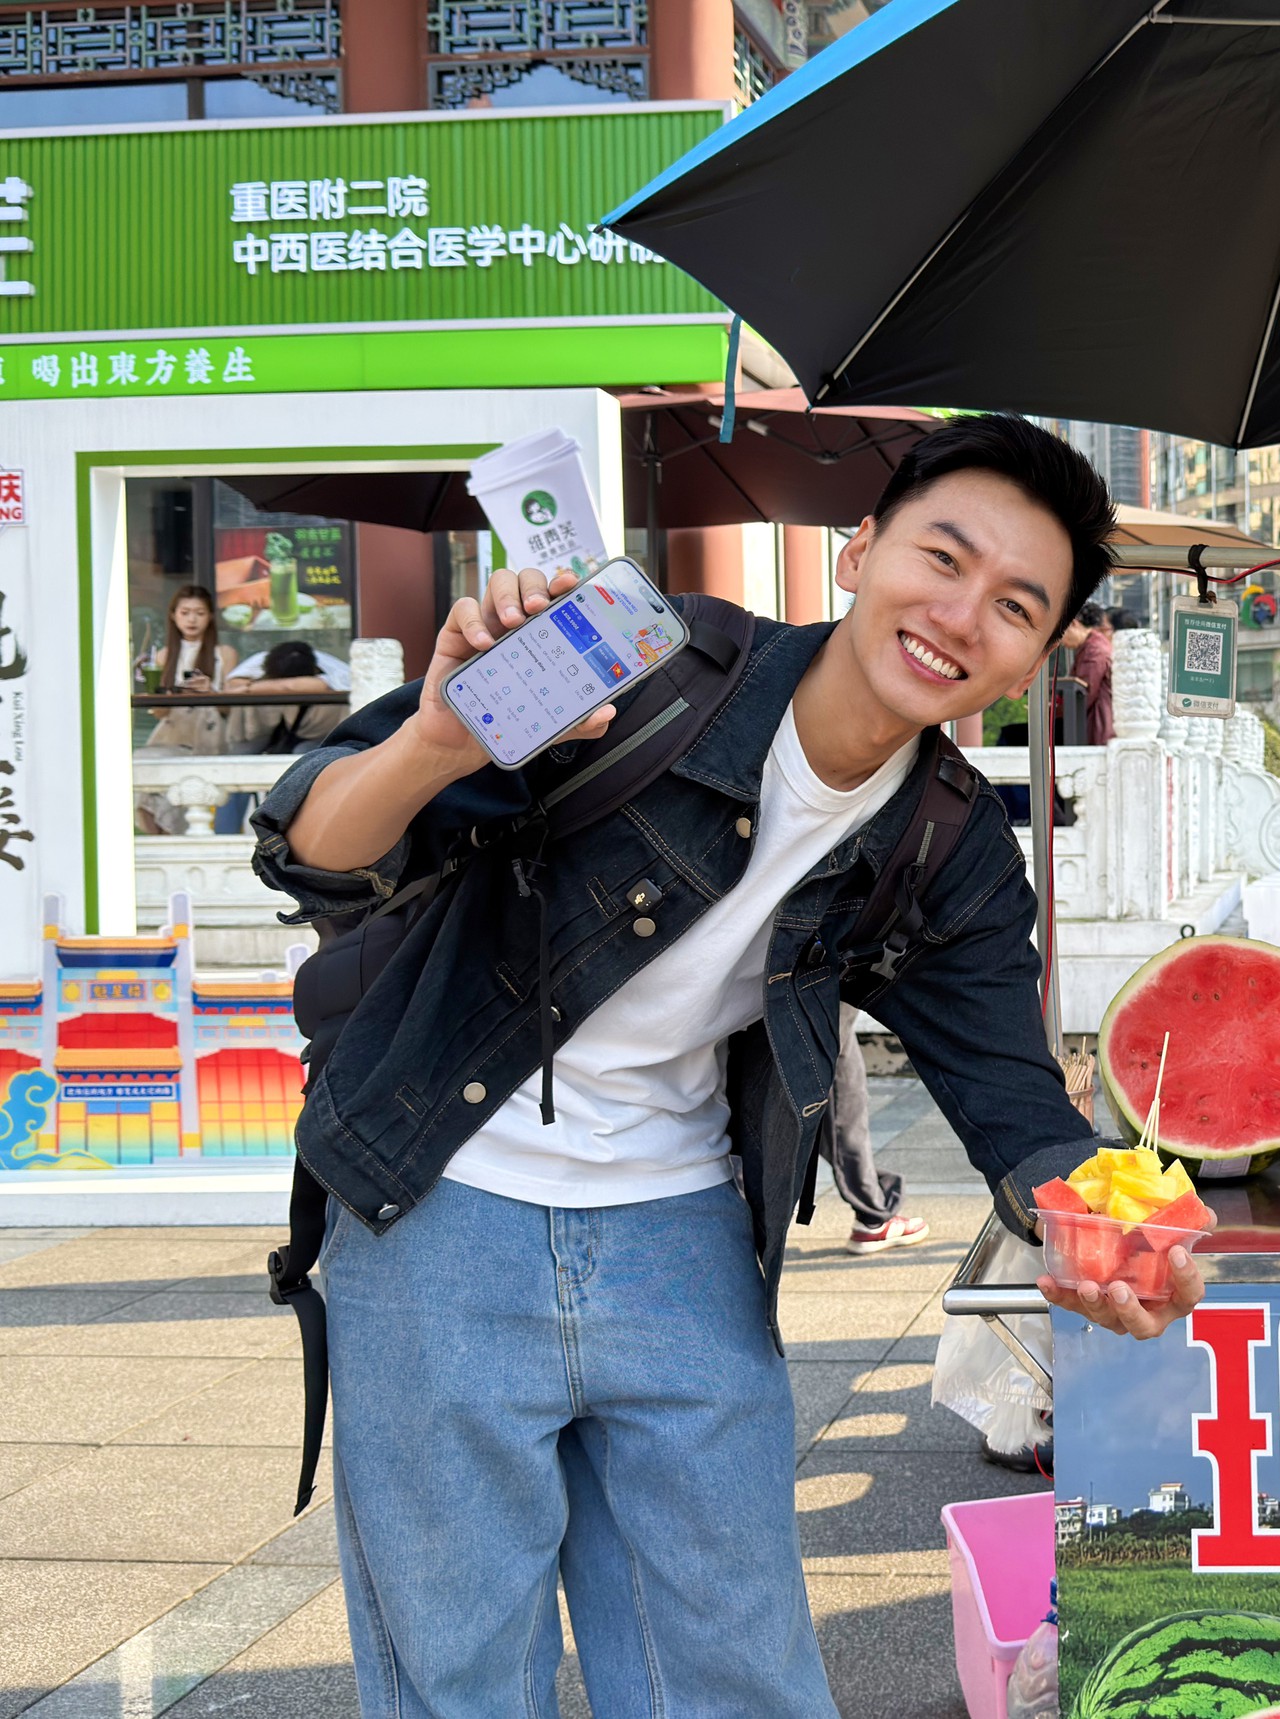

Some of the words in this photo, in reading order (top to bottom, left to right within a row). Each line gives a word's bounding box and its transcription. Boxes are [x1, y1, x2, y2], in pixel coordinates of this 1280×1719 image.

[230, 176, 429, 225] 重医附二院
[32, 346, 256, 388] 喝出東方養生
